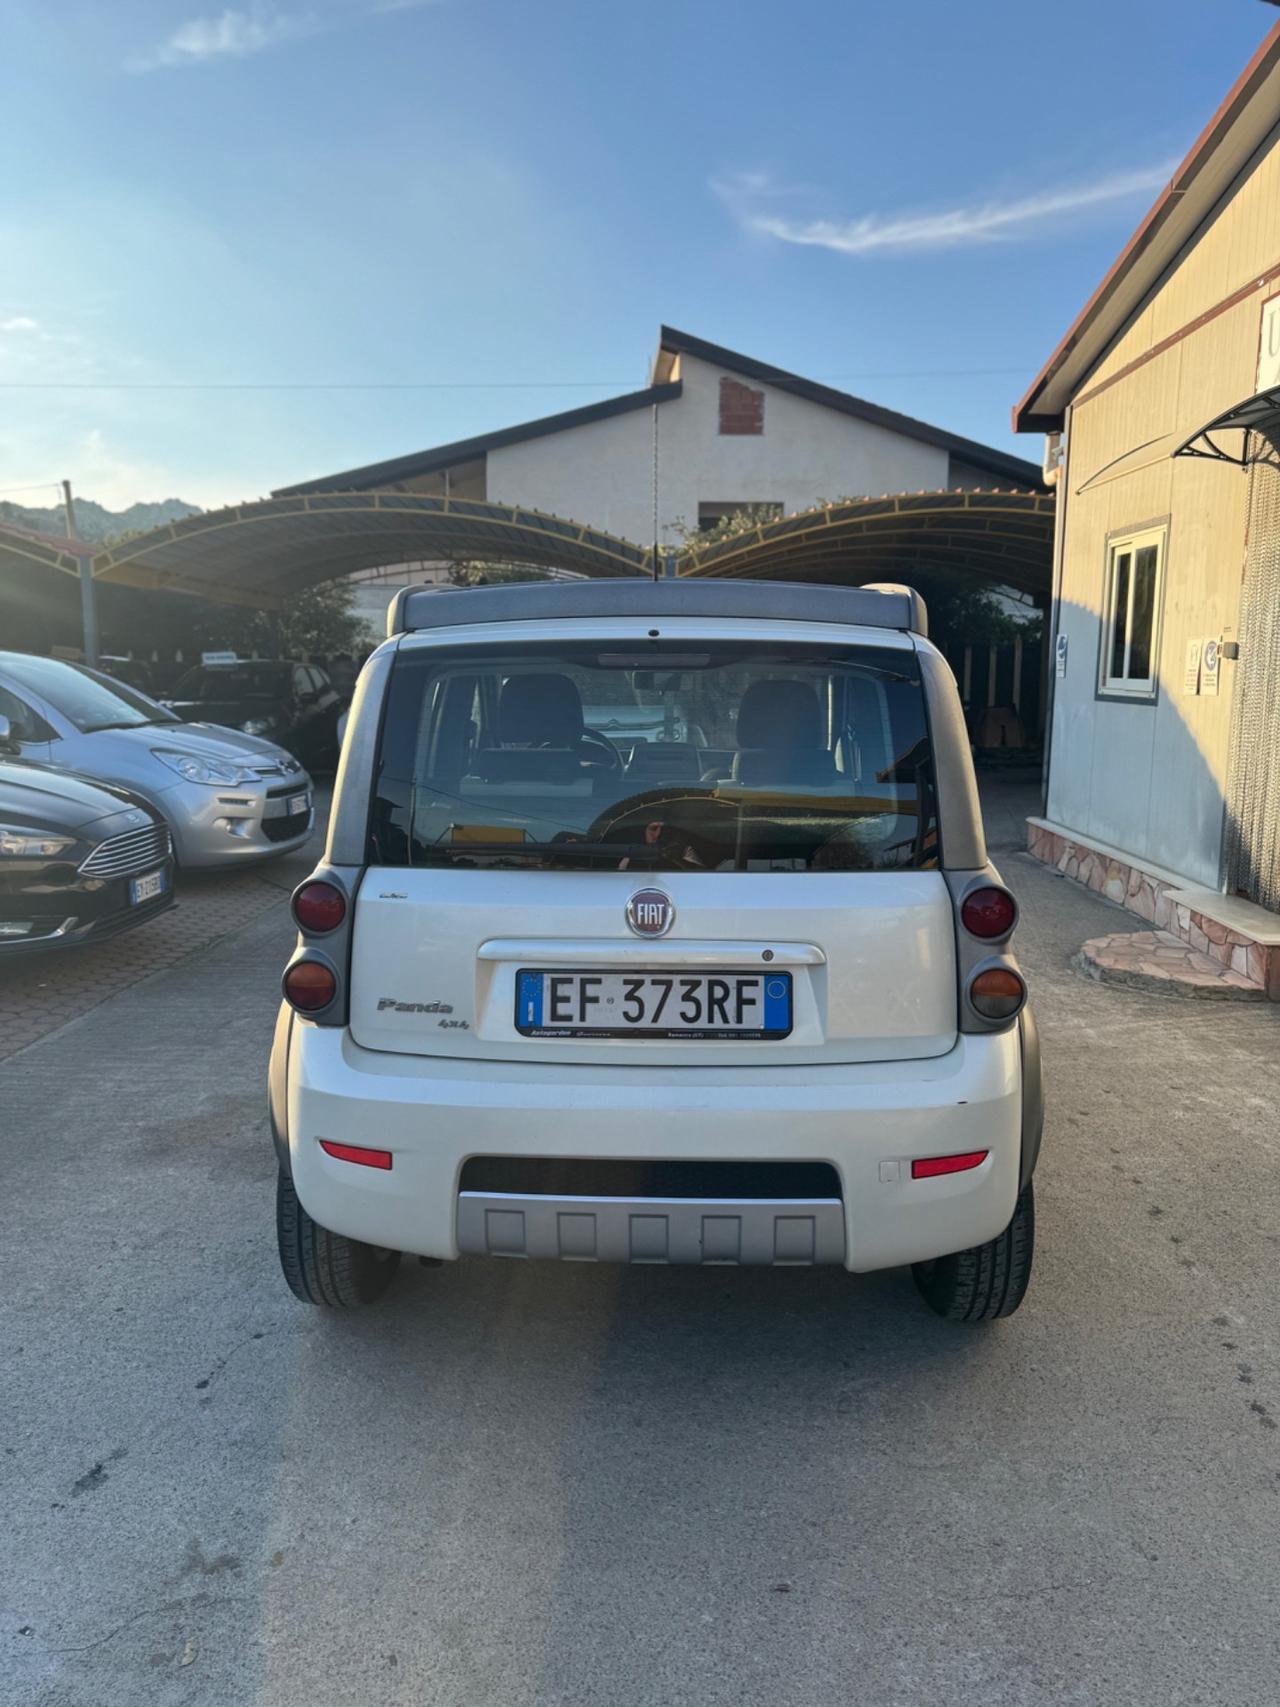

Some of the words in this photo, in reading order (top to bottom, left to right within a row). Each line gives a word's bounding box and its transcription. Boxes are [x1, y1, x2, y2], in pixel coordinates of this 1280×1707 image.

[637, 903, 665, 925] FIAT
[377, 998, 453, 1014] Panda
[550, 977, 602, 1022] EF
[622, 978, 759, 1024] 373RF
[437, 1019, 470, 1030] 4x4
